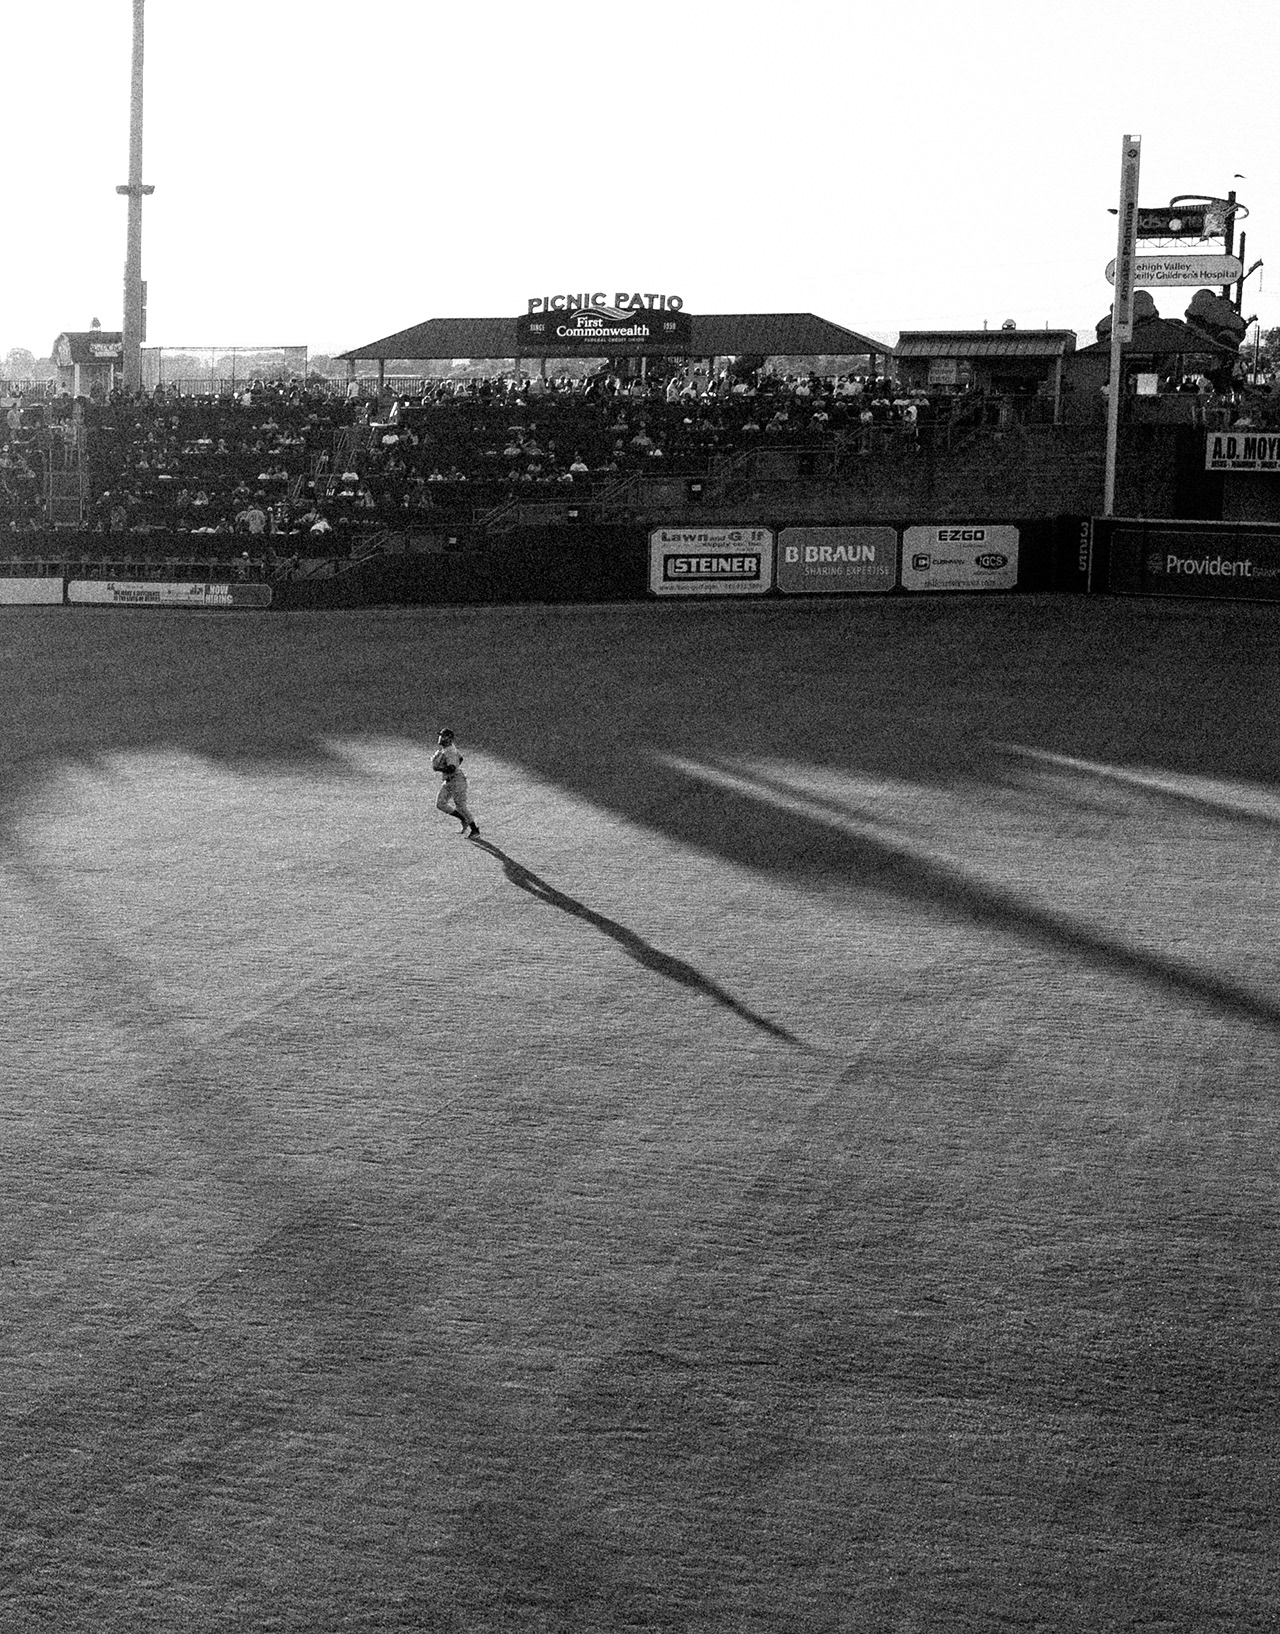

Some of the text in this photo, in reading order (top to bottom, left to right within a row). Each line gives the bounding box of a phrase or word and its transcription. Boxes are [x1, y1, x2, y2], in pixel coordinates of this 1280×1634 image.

[1136, 262, 1191, 272] ehigh Valley
[1156, 271, 1198, 280] Children's
[1200, 270, 1238, 279] Hospital
[528, 292, 683, 314] PICNIC PATIO
[577, 316, 603, 327] First
[556, 324, 649, 336] Commonwealth
[1212, 437, 1280, 460] A.D. MOY
[660, 531, 708, 541] Lawn
[728, 531, 764, 541] Glf
[805, 545, 875, 563] BRAUN
[674, 557, 758, 573] STEINER
[1166, 554, 1252, 577] Provident
[805, 566, 890, 576] SHARING EXPERTISE
[209, 585, 228, 594] NOW
